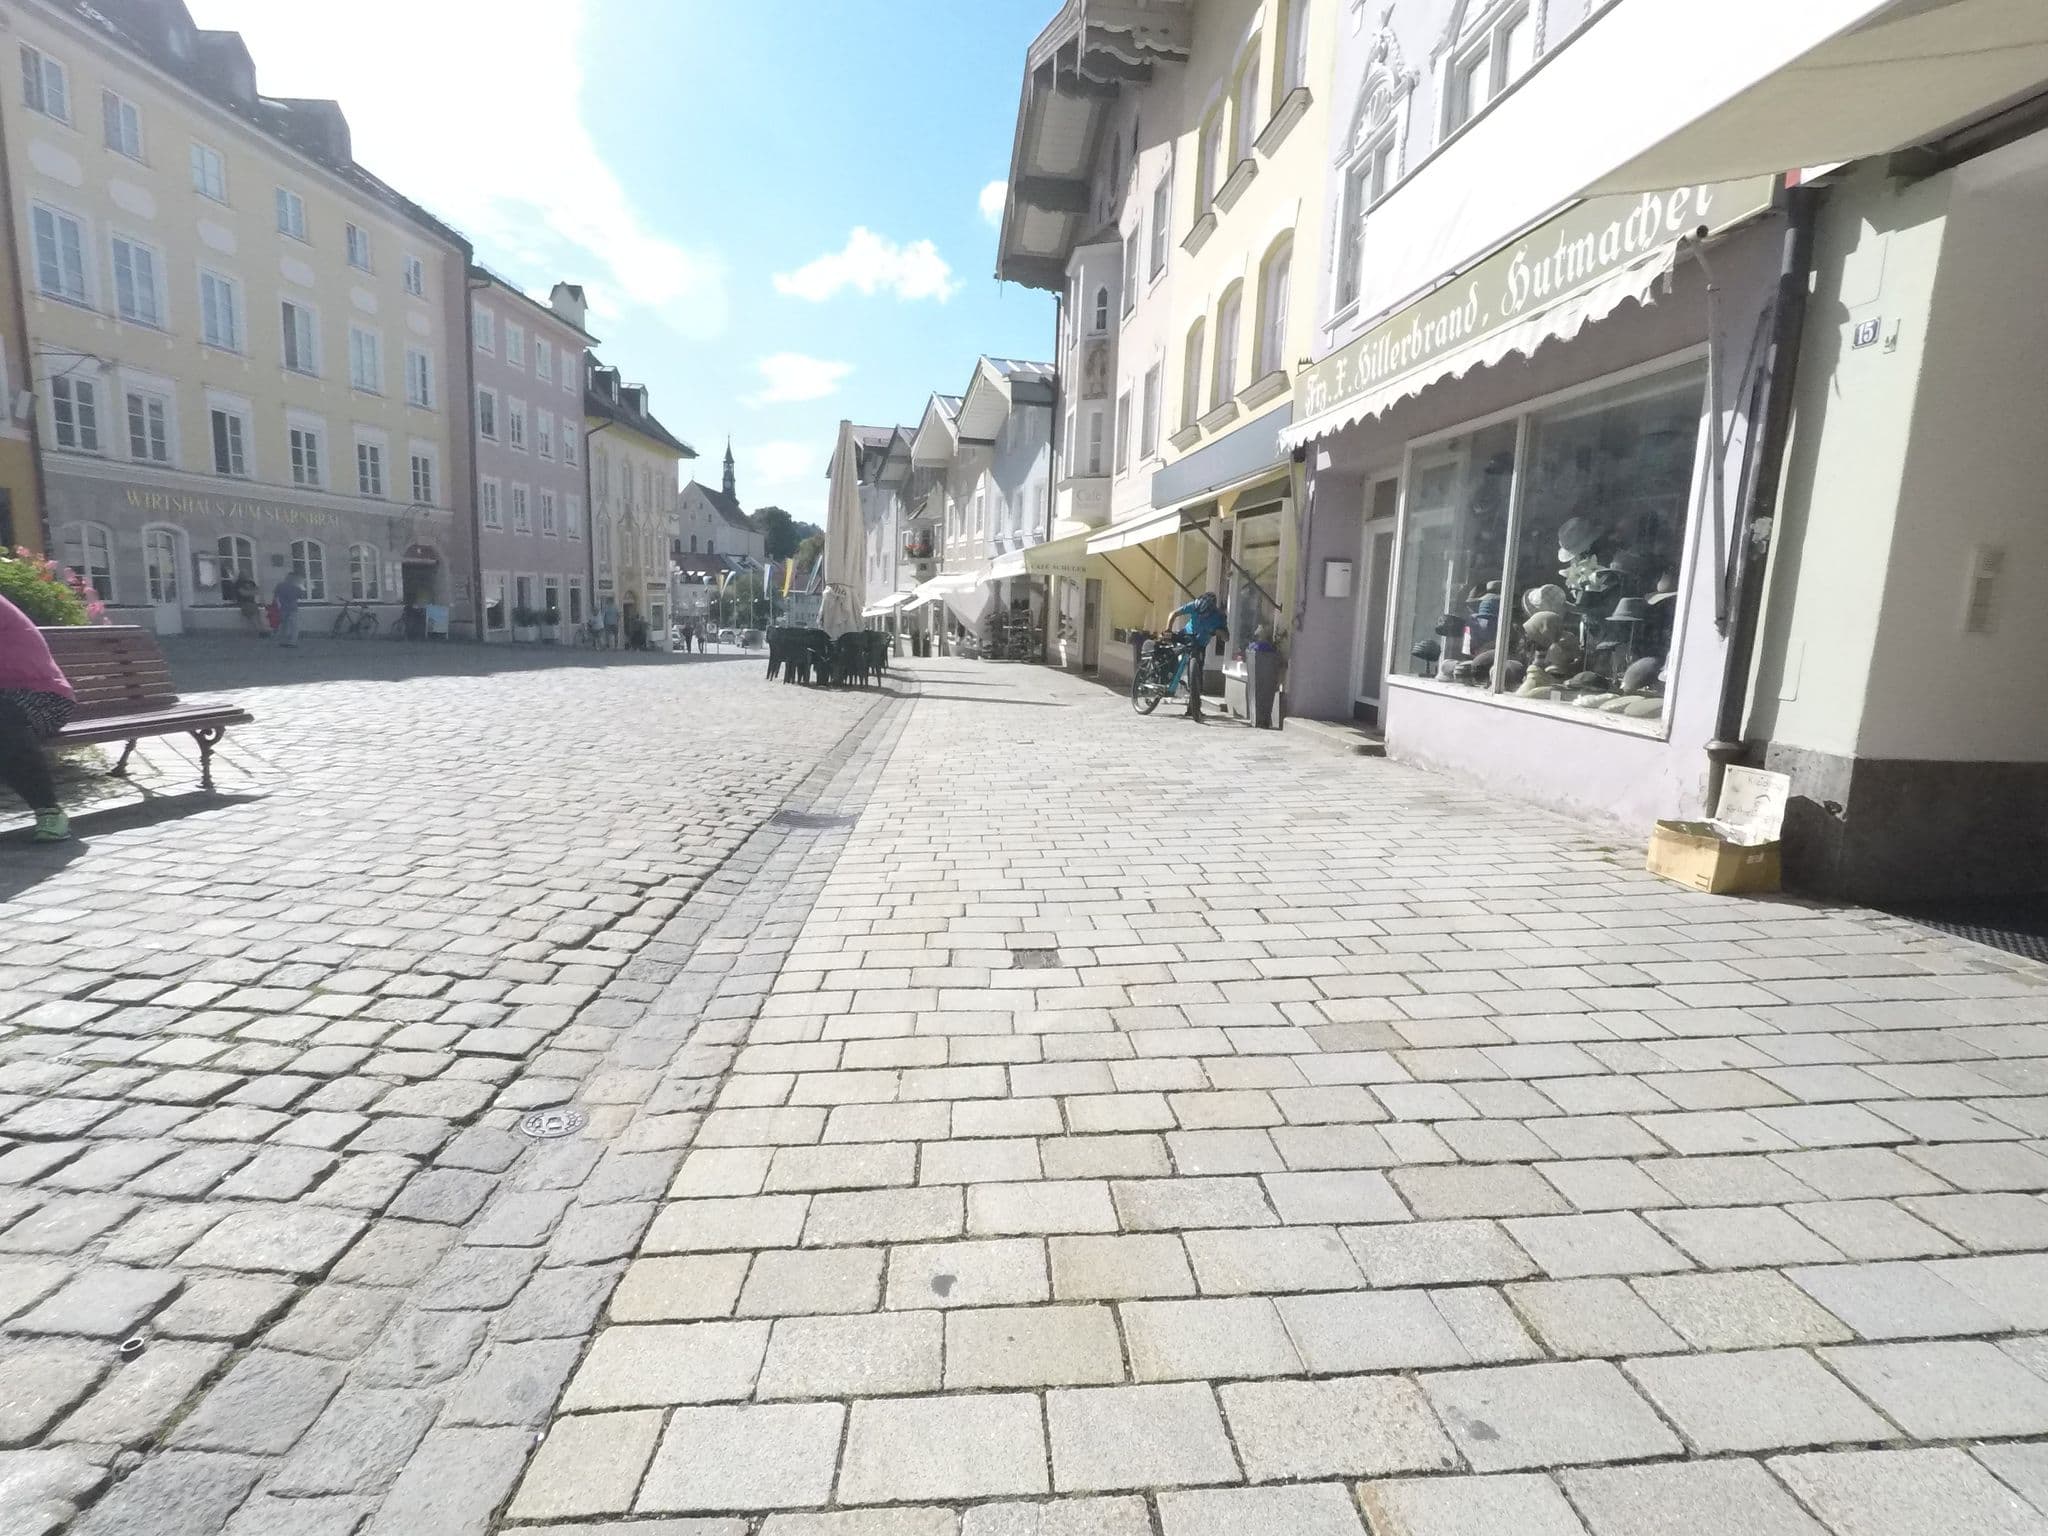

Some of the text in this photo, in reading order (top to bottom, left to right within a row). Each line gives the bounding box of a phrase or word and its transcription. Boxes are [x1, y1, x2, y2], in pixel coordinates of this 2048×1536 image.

[1857, 319, 1875, 345] 15
[127, 488, 225, 518] WIRTSHAUS
[229, 502, 262, 522] ZUM
